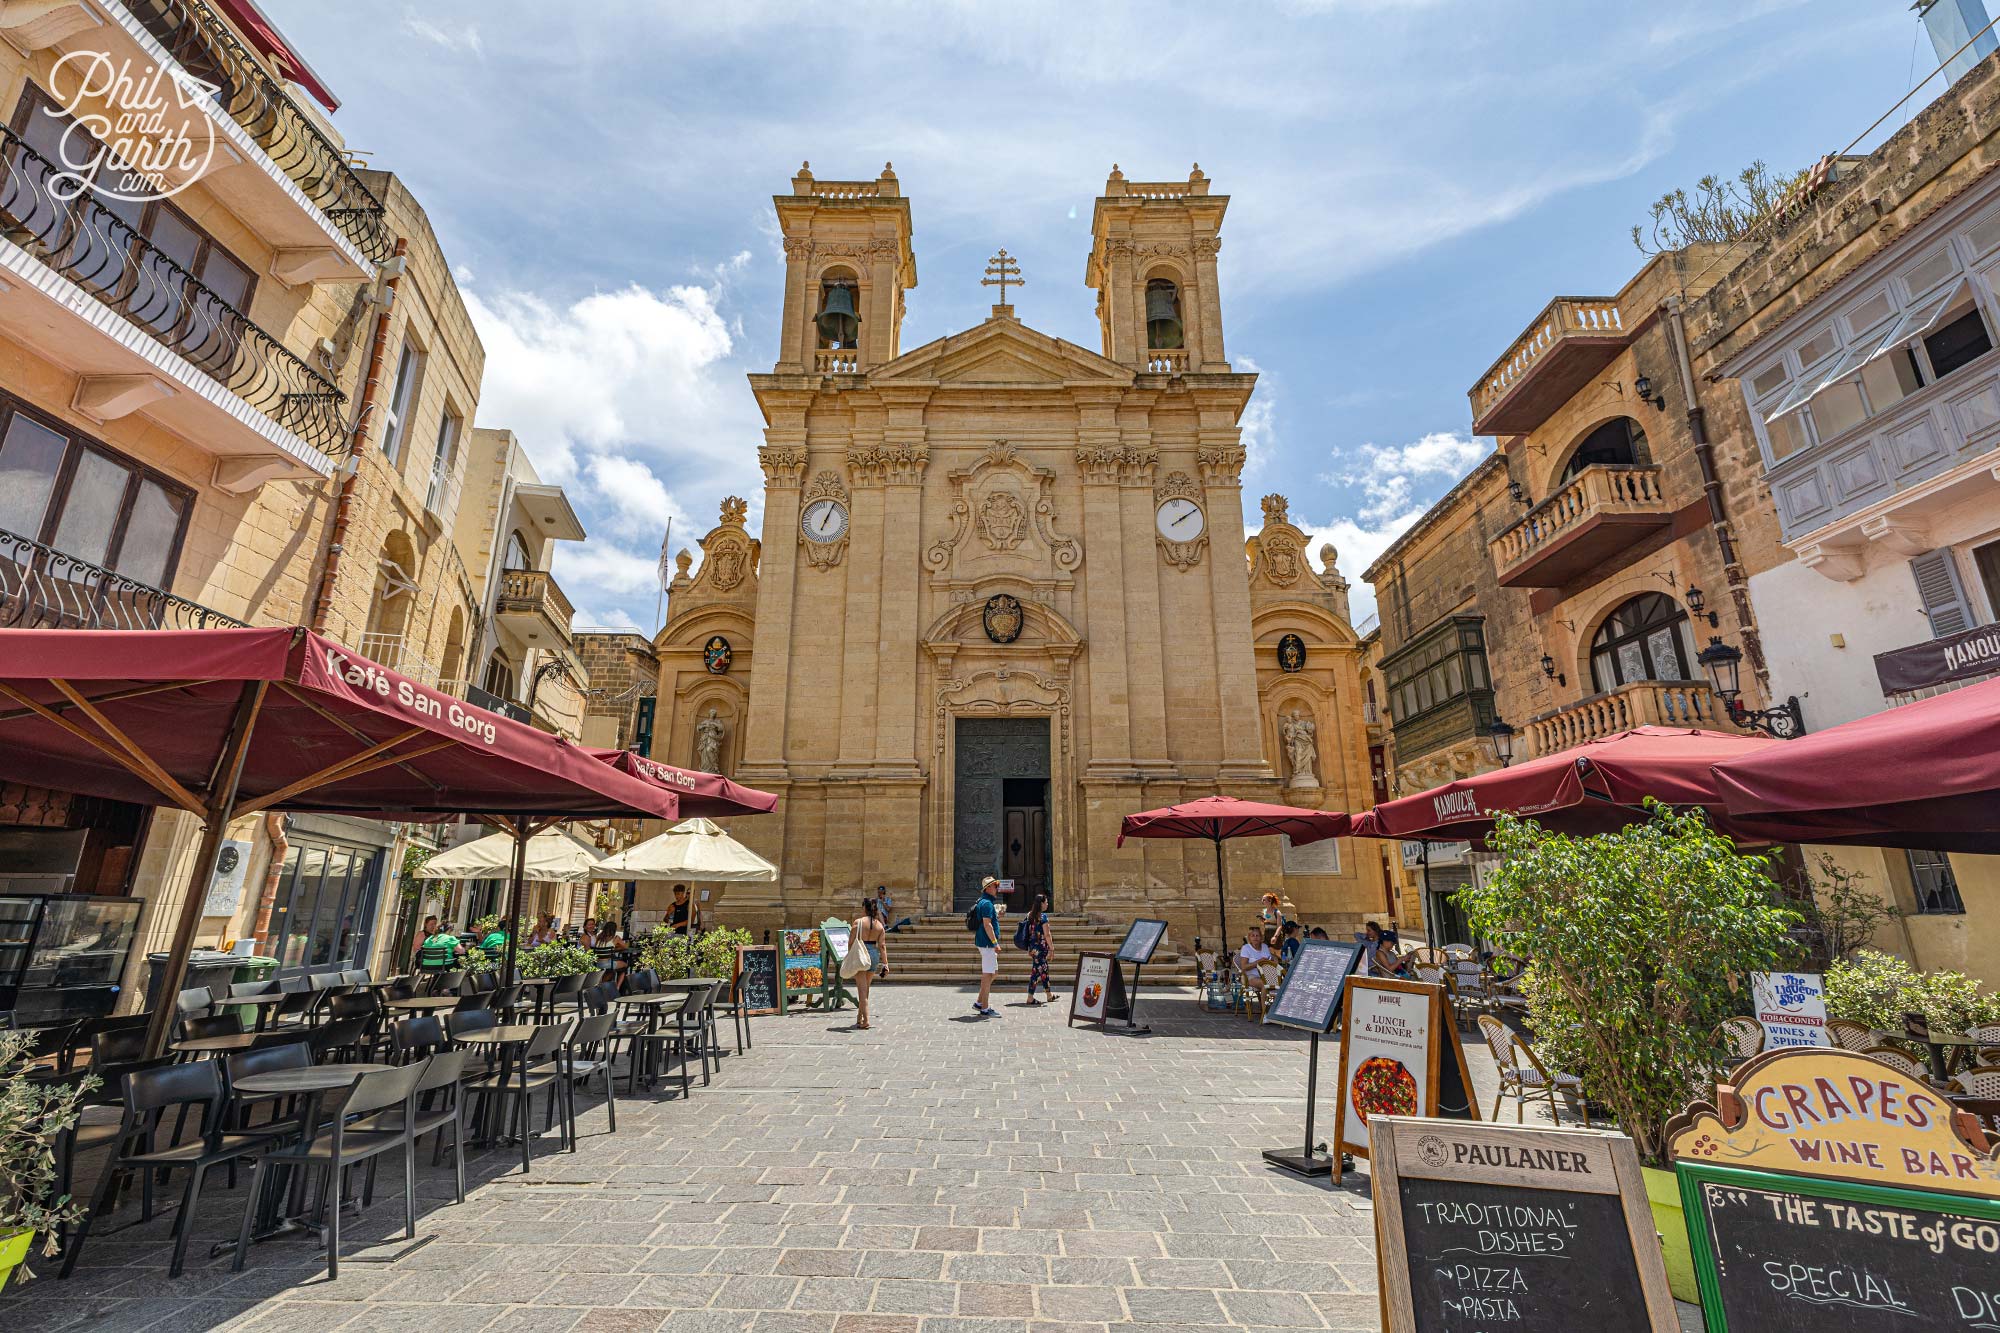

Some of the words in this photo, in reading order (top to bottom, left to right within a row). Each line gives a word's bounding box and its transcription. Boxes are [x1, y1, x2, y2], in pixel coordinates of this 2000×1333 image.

[397, 681, 442, 720] San
[657, 766, 675, 783] San
[1433, 789, 1481, 823] MANOUCHE
[1775, 984, 1819, 997] Liqueur
[1782, 974, 1806, 986] The
[1779, 993, 1806, 1006] Shop
[1365, 1023, 1373, 1032] &
[1374, 1024, 1413, 1039] DINNER
[1372, 1014, 1407, 1028] LUNCH
[1761, 1014, 1822, 1026] TOBACCONIST
[1768, 1026, 1805, 1037] WINES
[1809, 1029, 1817, 1038] &
[1772, 1036, 1816, 1046] SPIRITS
[1754, 1075, 1937, 1130] GRAPES
[1452, 1142, 1592, 1174] PAULANER
[1789, 1137, 1886, 1171] WINE
[1900, 1147, 1980, 1180] BAR
[1764, 1194, 1820, 1226] THE
[1824, 1203, 1920, 1241] TASTE
[1921, 1220, 1948, 1254] of
[1455, 1264, 1529, 1291] PIZZA
[1763, 1261, 1907, 1307] SPECIAL
[1461, 1296, 1521, 1319] PASTA
[1951, 1286, 2000, 1320] DI
